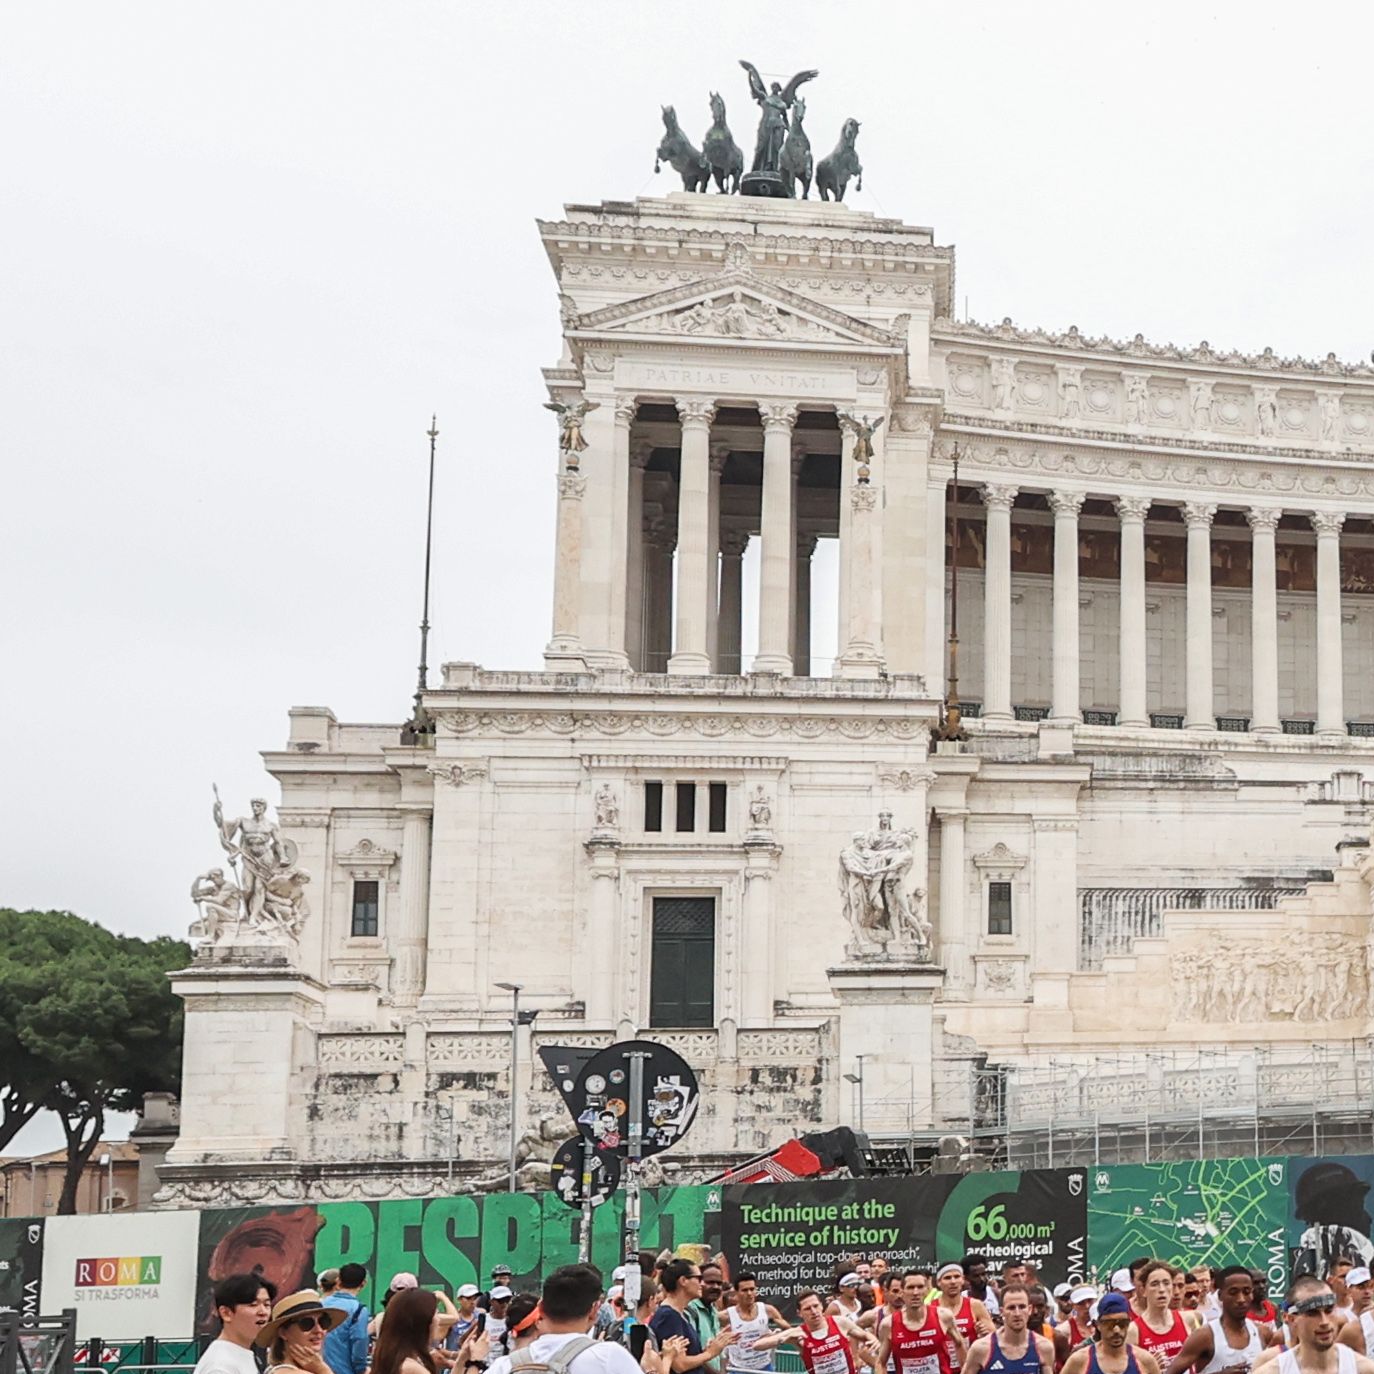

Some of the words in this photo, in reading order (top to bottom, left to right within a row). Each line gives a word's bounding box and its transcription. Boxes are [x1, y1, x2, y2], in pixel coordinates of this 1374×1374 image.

[646, 368, 729, 384] PATRIAE
[739, 1203, 838, 1226] Technique
[841, 1202, 860, 1220] at
[863, 1199, 896, 1219] the
[967, 1204, 1035, 1241] 66,000
[739, 1228, 806, 1249] service
[809, 1226, 830, 1246] of
[833, 1225, 899, 1248] history
[816, 1249, 866, 1269] top-don
[966, 1240, 1053, 1259] archeological
[1067, 1236, 1084, 1286] OMA
[1267, 1227, 1285, 1298] ROMA
[78, 1261, 158, 1283] ROMA
[757, 1267, 799, 1281] method
[799, 1266, 816, 1280] for
[22, 1279, 38, 1329] OMA
[74, 1289, 85, 1302] SI
[88, 1287, 160, 1302] TRASFORMA
[811, 1341, 841, 1355] AUSTRIA
[900, 1338, 934, 1350] AUSTRIA
[1148, 1340, 1183, 1353] AUSTRIA
